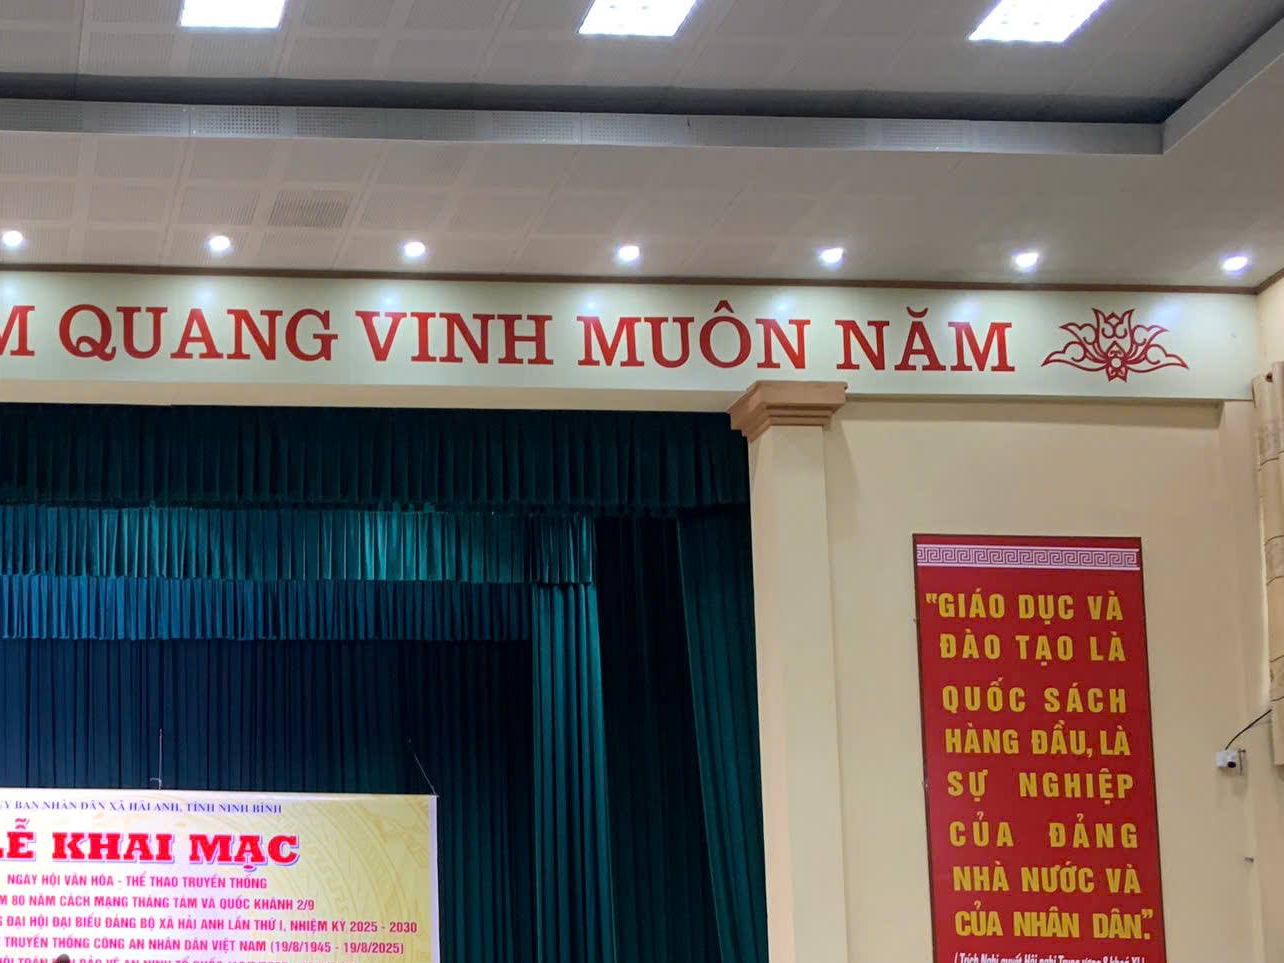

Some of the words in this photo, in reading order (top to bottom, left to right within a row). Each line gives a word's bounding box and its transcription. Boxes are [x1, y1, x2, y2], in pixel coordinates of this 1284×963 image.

[59, 304, 338, 362] QUANG
[355, 311, 552, 365] VINH
[578, 300, 811, 369] MUÔN
[835, 309, 1016, 373] NĂM
[1018, 594, 1074, 624] DỤC
[1088, 591, 1123, 620] VÀ
[940, 628, 1000, 659] ĐÀO
[1016, 635, 1073, 666] TẠO
[1090, 632, 1125, 661] LÀ
[942, 678, 1026, 714] QUỐC
[1044, 682, 1126, 713] SÁCH
[945, 723, 1019, 754] HÀNG
[1031, 721, 1092, 757] ĐẦU,
[1100, 726, 1130, 755] LÀ
[947, 769, 988, 802] SỰ
[1019, 768, 1133, 804] NGHIỆP
[950, 811, 1014, 847] CỦA
[1049, 813, 1137, 848] ĐẢNG
[52, 832, 173, 862] KHAI
[189, 834, 298, 870] MẠC
[953, 861, 1009, 891] NHÀ
[1021, 861, 1094, 892] NƯỚC
[1106, 864, 1140, 893] VÀ
[955, 901, 1003, 936] CỦA
[1014, 906, 1080, 938] NHÂN
